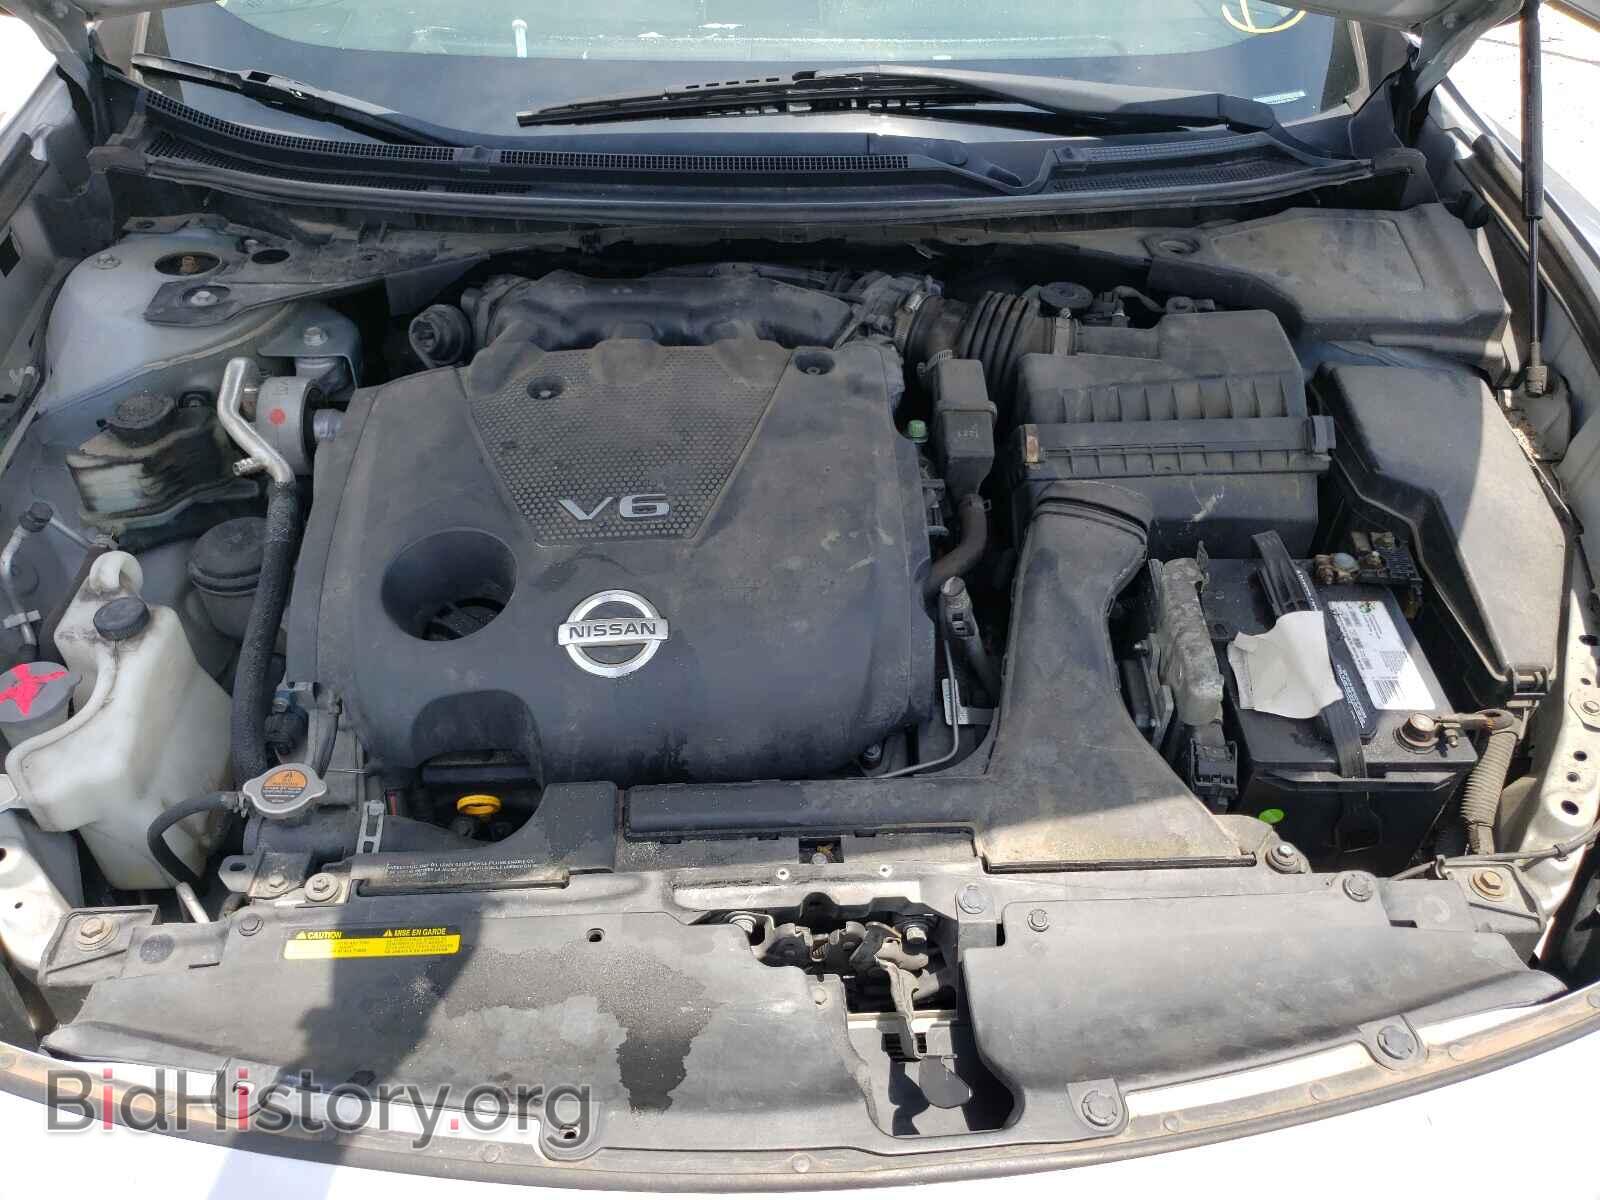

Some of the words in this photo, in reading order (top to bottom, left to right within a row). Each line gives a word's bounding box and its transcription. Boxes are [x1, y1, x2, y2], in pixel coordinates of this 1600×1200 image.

[559, 493, 670, 521] V6
[569, 622, 657, 640] NISSAN
[307, 931, 342, 939] CAUTION
[411, 928, 422, 936] EN
[423, 927, 447, 936] GARDE
